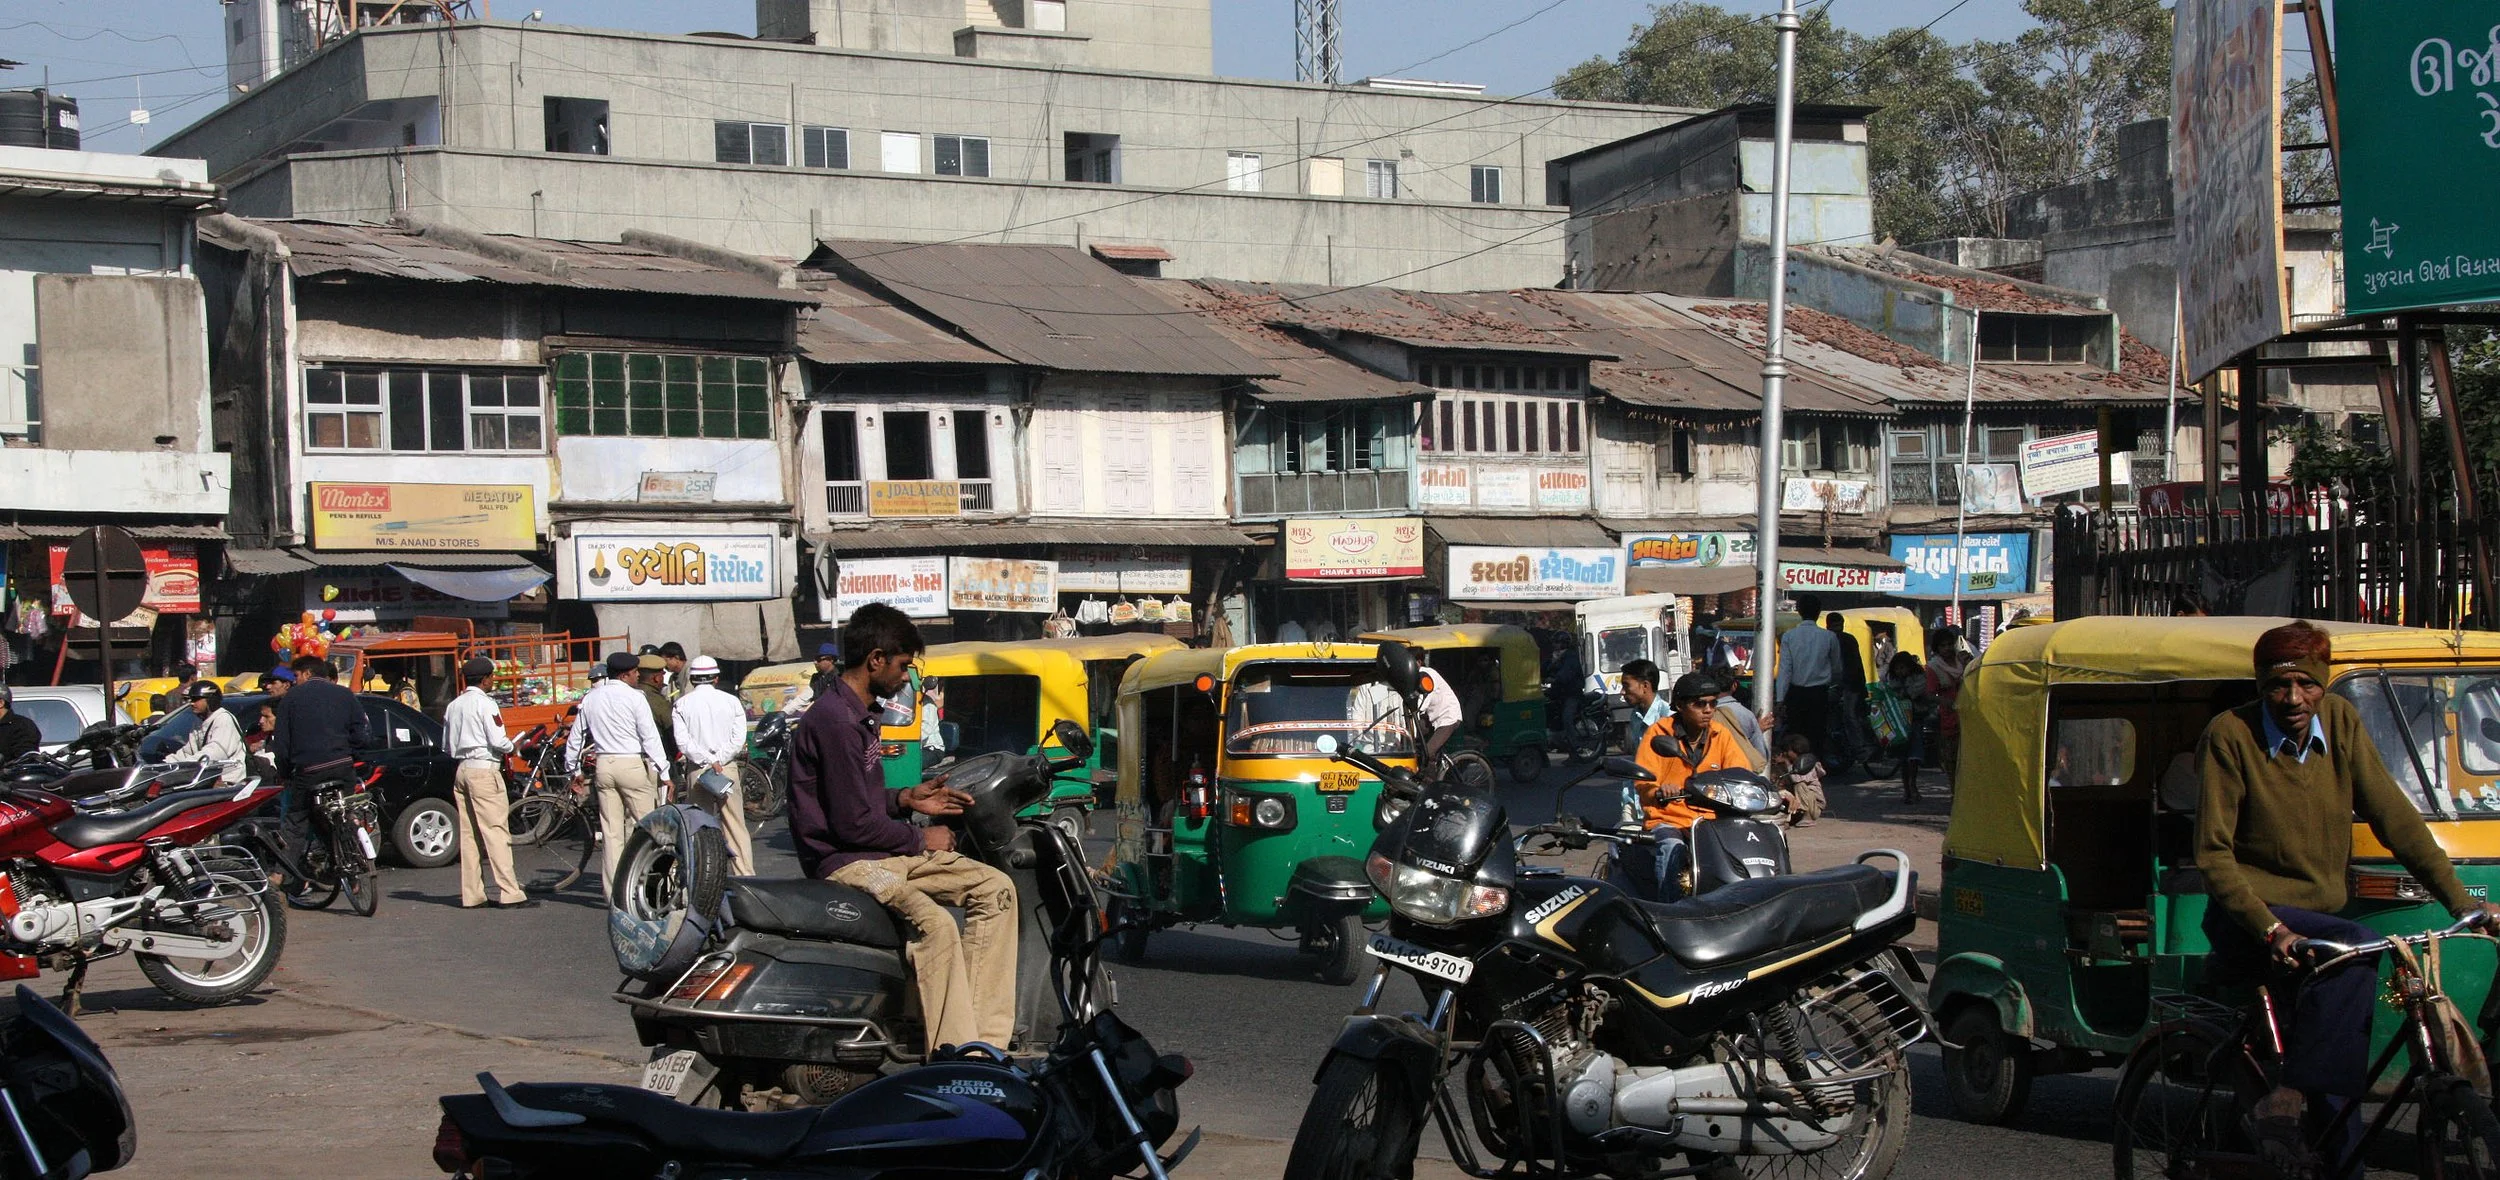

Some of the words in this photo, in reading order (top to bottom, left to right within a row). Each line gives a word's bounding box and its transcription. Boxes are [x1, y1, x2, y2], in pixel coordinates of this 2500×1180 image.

[2364, 268, 2414, 295] ગુજરાત
[321, 487, 386, 508] Montex
[463, 490, 522, 503] MEGATOP
[375, 537, 397, 546] M/S.
[400, 538, 437, 547] ANAND
[439, 538, 480, 547] STORES
[1332, 535, 1375, 546] MADHUR
[1319, 568, 1355, 577] CHAWLA
[1356, 567, 1387, 576] STORES
[1471, 555, 1530, 582] કટલરી
[1786, 569, 1834, 585] કલ્પના
[1338, 774, 1358, 787] 6366
[1415, 856, 1455, 875] VIZUKI
[2465, 887, 2486, 897] NG
[1524, 884, 1585, 925] SUZUKI
[1688, 977, 1747, 1005] Fiero
[649, 1073, 675, 1091] 900
[951, 1079, 994, 1088] HERO
[937, 1085, 1007, 1098] HONDA
